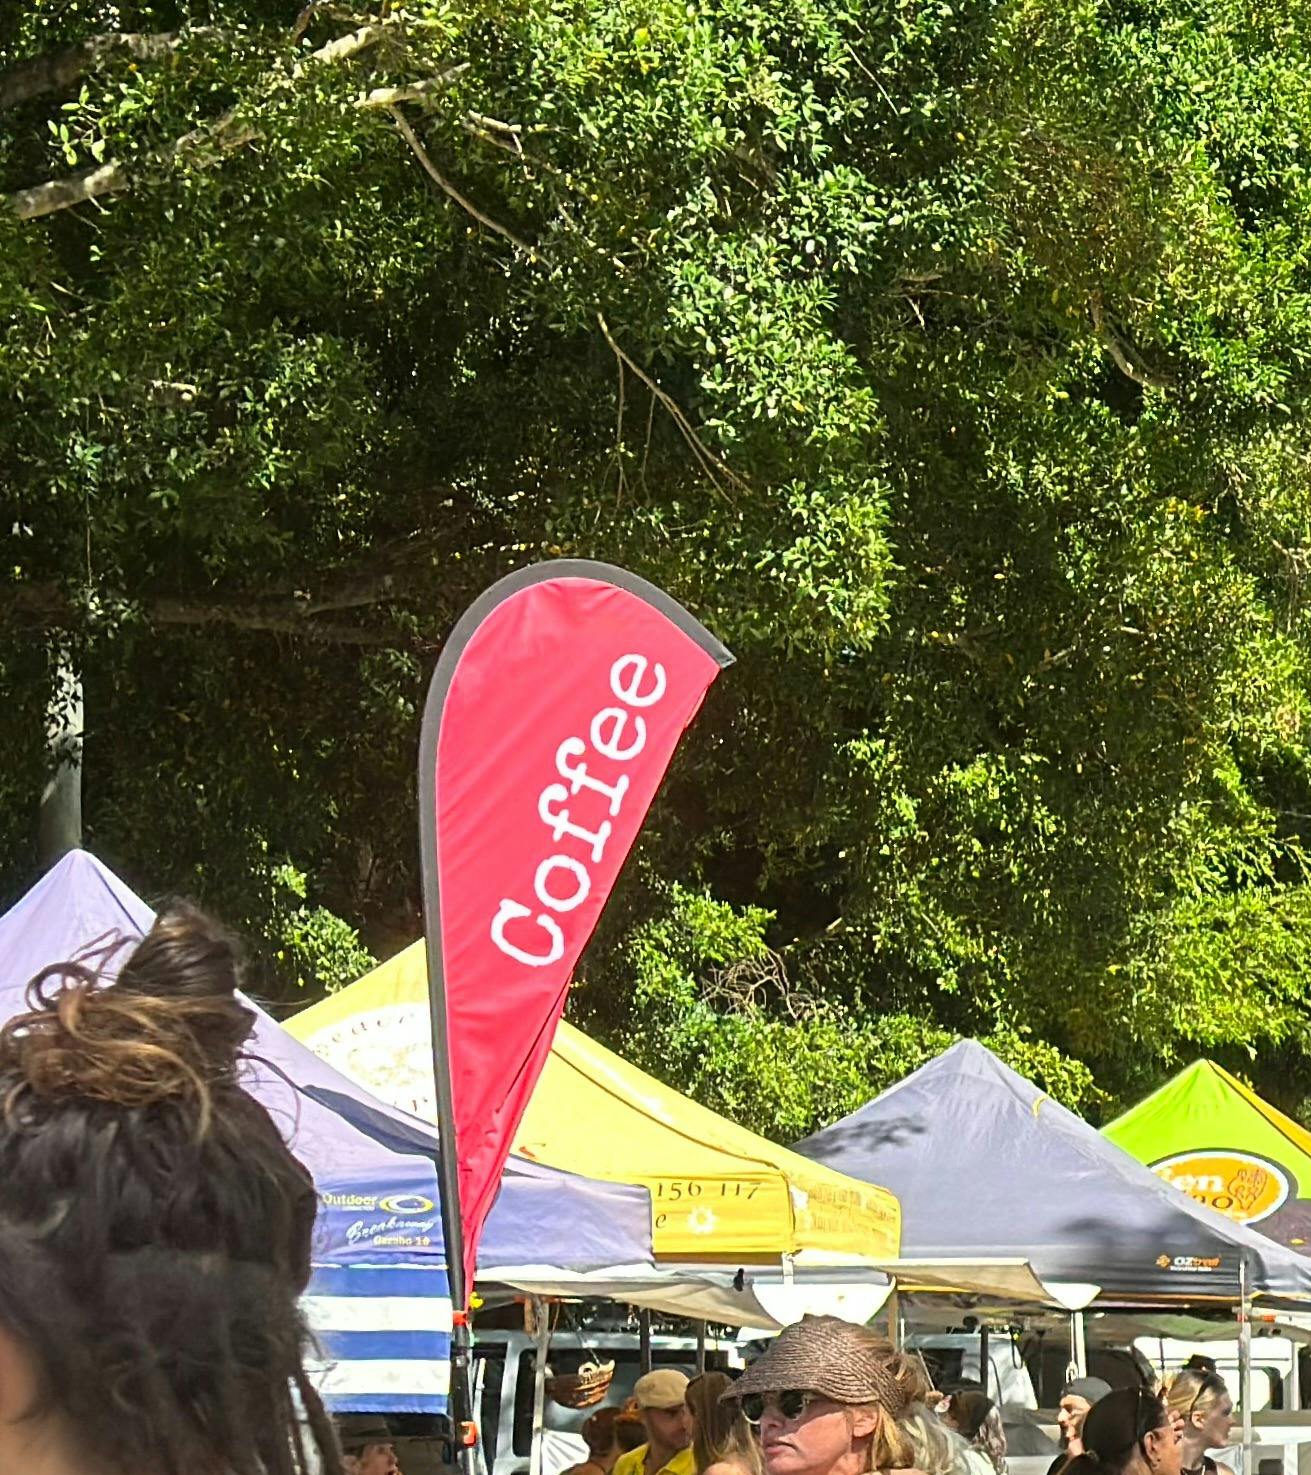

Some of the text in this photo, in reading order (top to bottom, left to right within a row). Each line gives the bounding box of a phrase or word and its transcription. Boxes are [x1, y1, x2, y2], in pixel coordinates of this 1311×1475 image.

[490, 653, 667, 967] Coffee
[657, 1182, 761, 1201] 156 117
